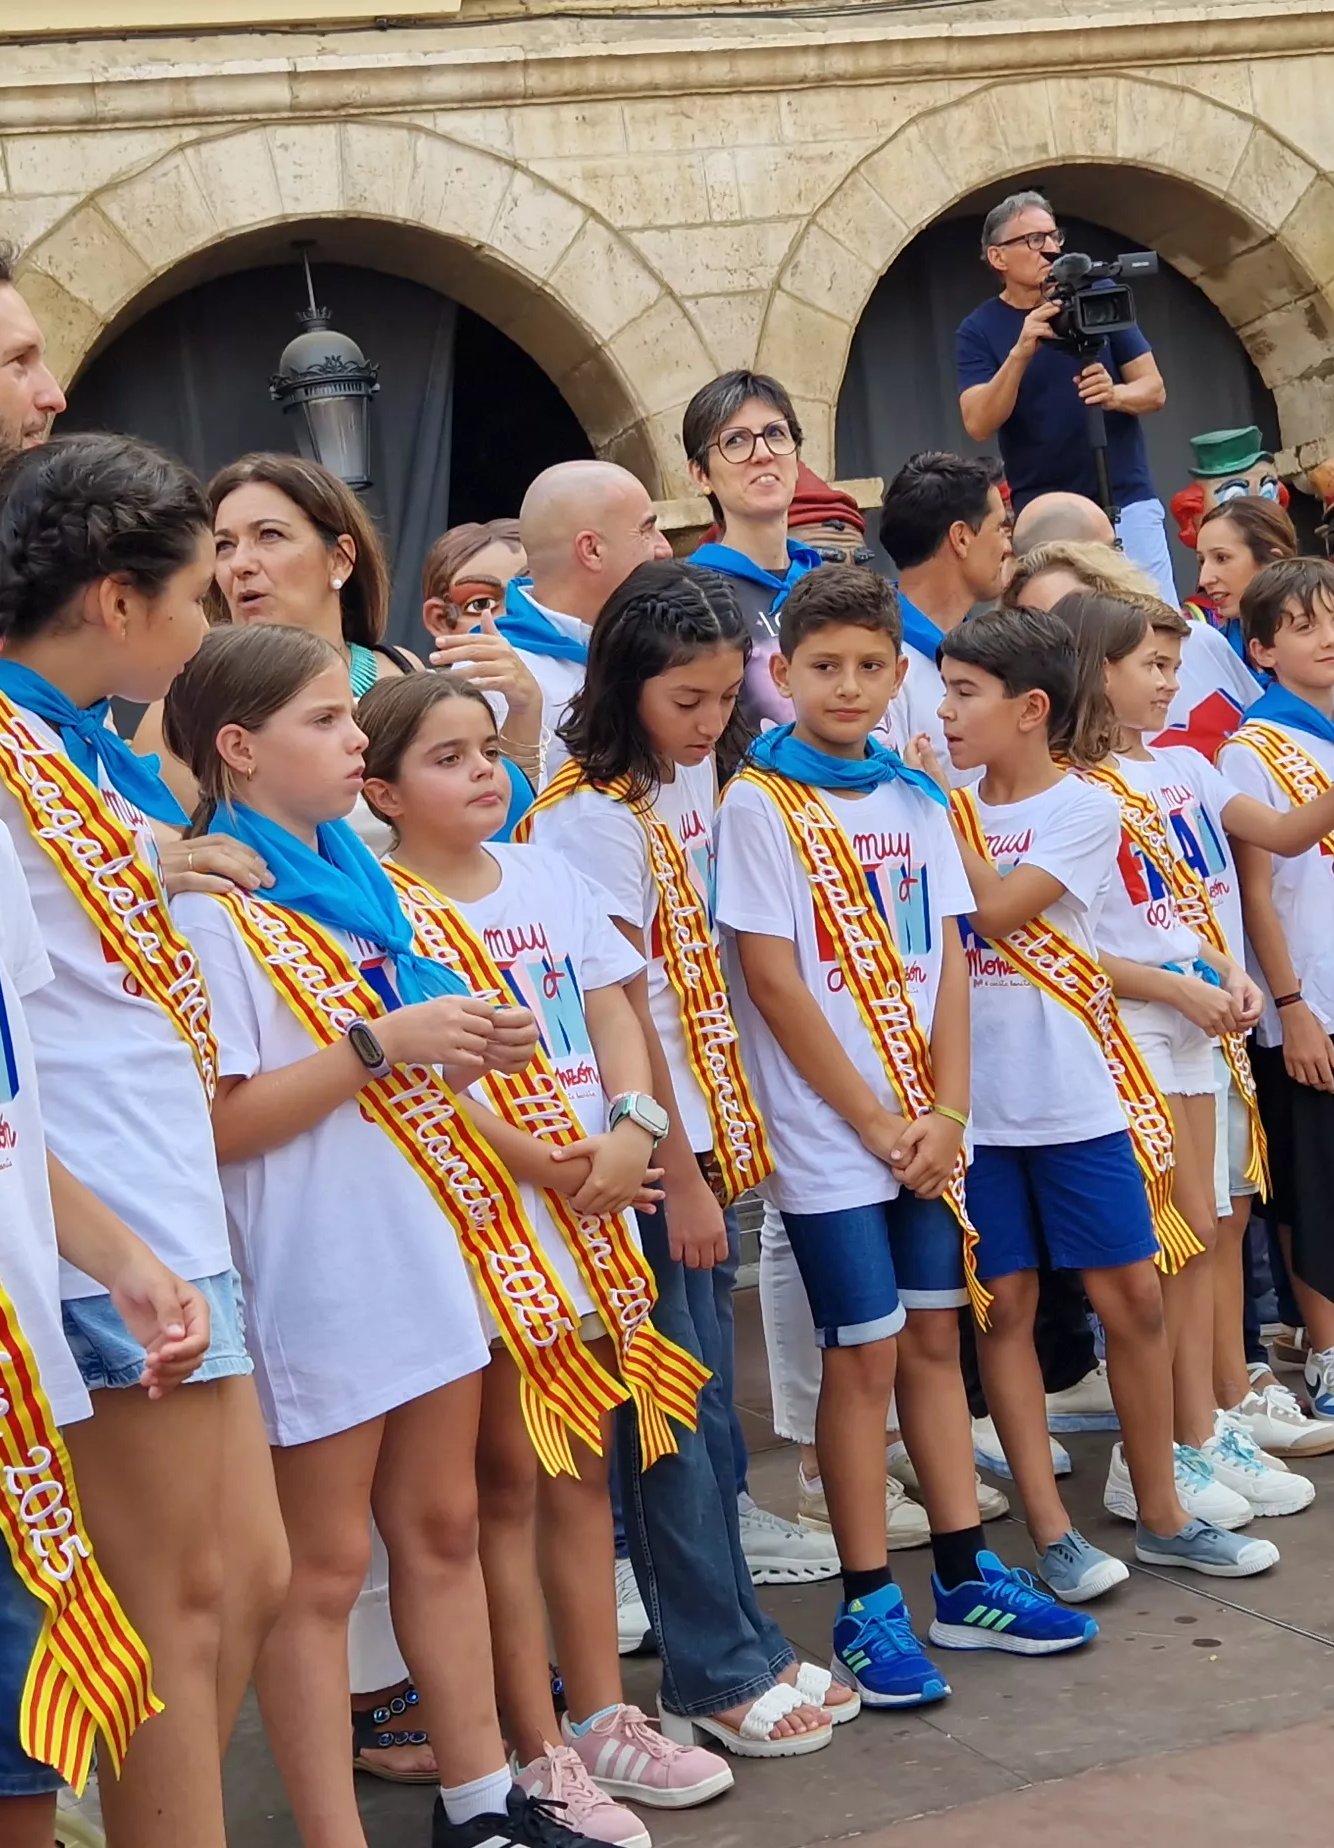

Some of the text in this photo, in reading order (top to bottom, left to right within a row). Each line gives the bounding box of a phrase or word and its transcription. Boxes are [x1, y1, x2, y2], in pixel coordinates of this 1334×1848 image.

[789, 801, 882, 980] Zagalete
[852, 832, 919, 902] muy
[483, 921, 565, 1000] muy
[696, 990, 757, 1173] Monzón
[1122, 1094, 1177, 1174] 2025
[486, 1242, 575, 1348] 2025
[3, 1445, 90, 1582] 2025
